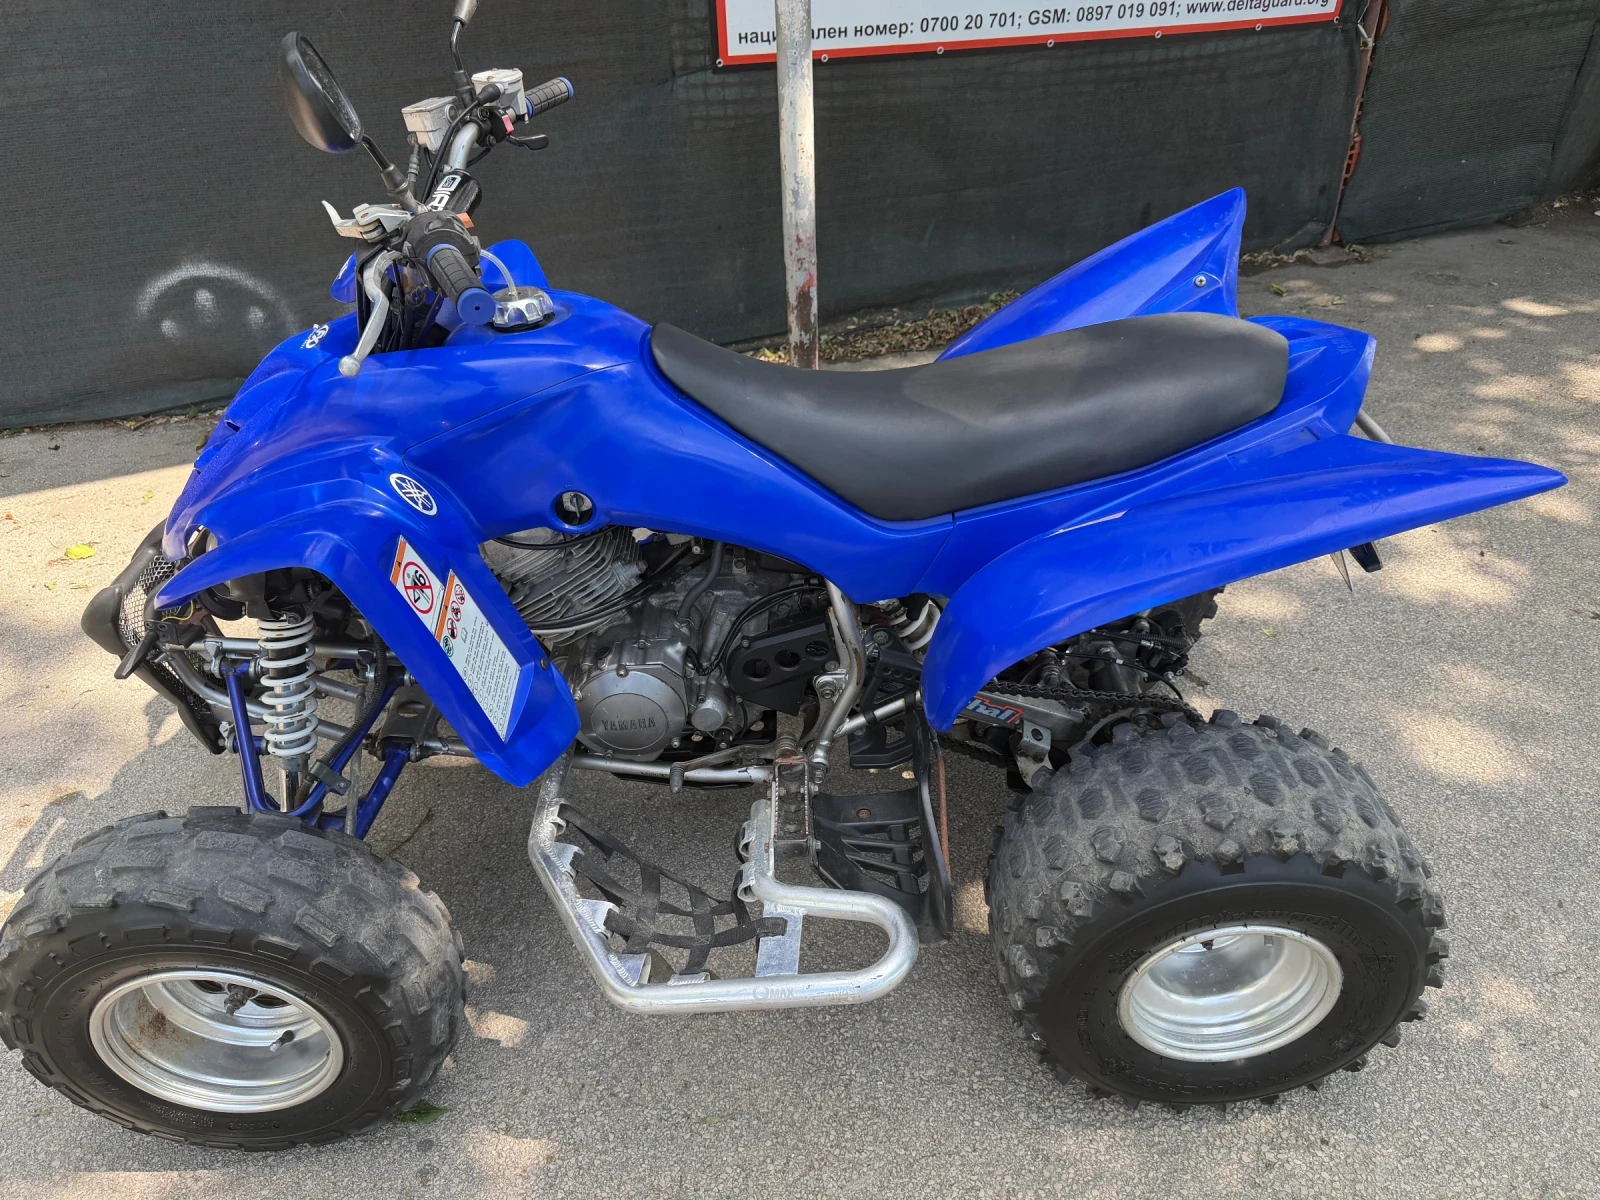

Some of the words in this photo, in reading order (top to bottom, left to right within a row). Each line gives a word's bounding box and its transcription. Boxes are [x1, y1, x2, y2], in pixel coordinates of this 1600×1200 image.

[854, 22, 914, 38] номер:
[920, 15, 959, 33] 0700
[964, 13, 983, 30] 20
[989, 11, 1022, 29] 701;
[1028, 8, 1071, 26] GSM:
[1076, 5, 1113, 22] 0897
[1117, 2, 1144, 19] 019
[1149, 0, 1181, 18] 091;
[601, 717, 656, 731] YAMAHA
